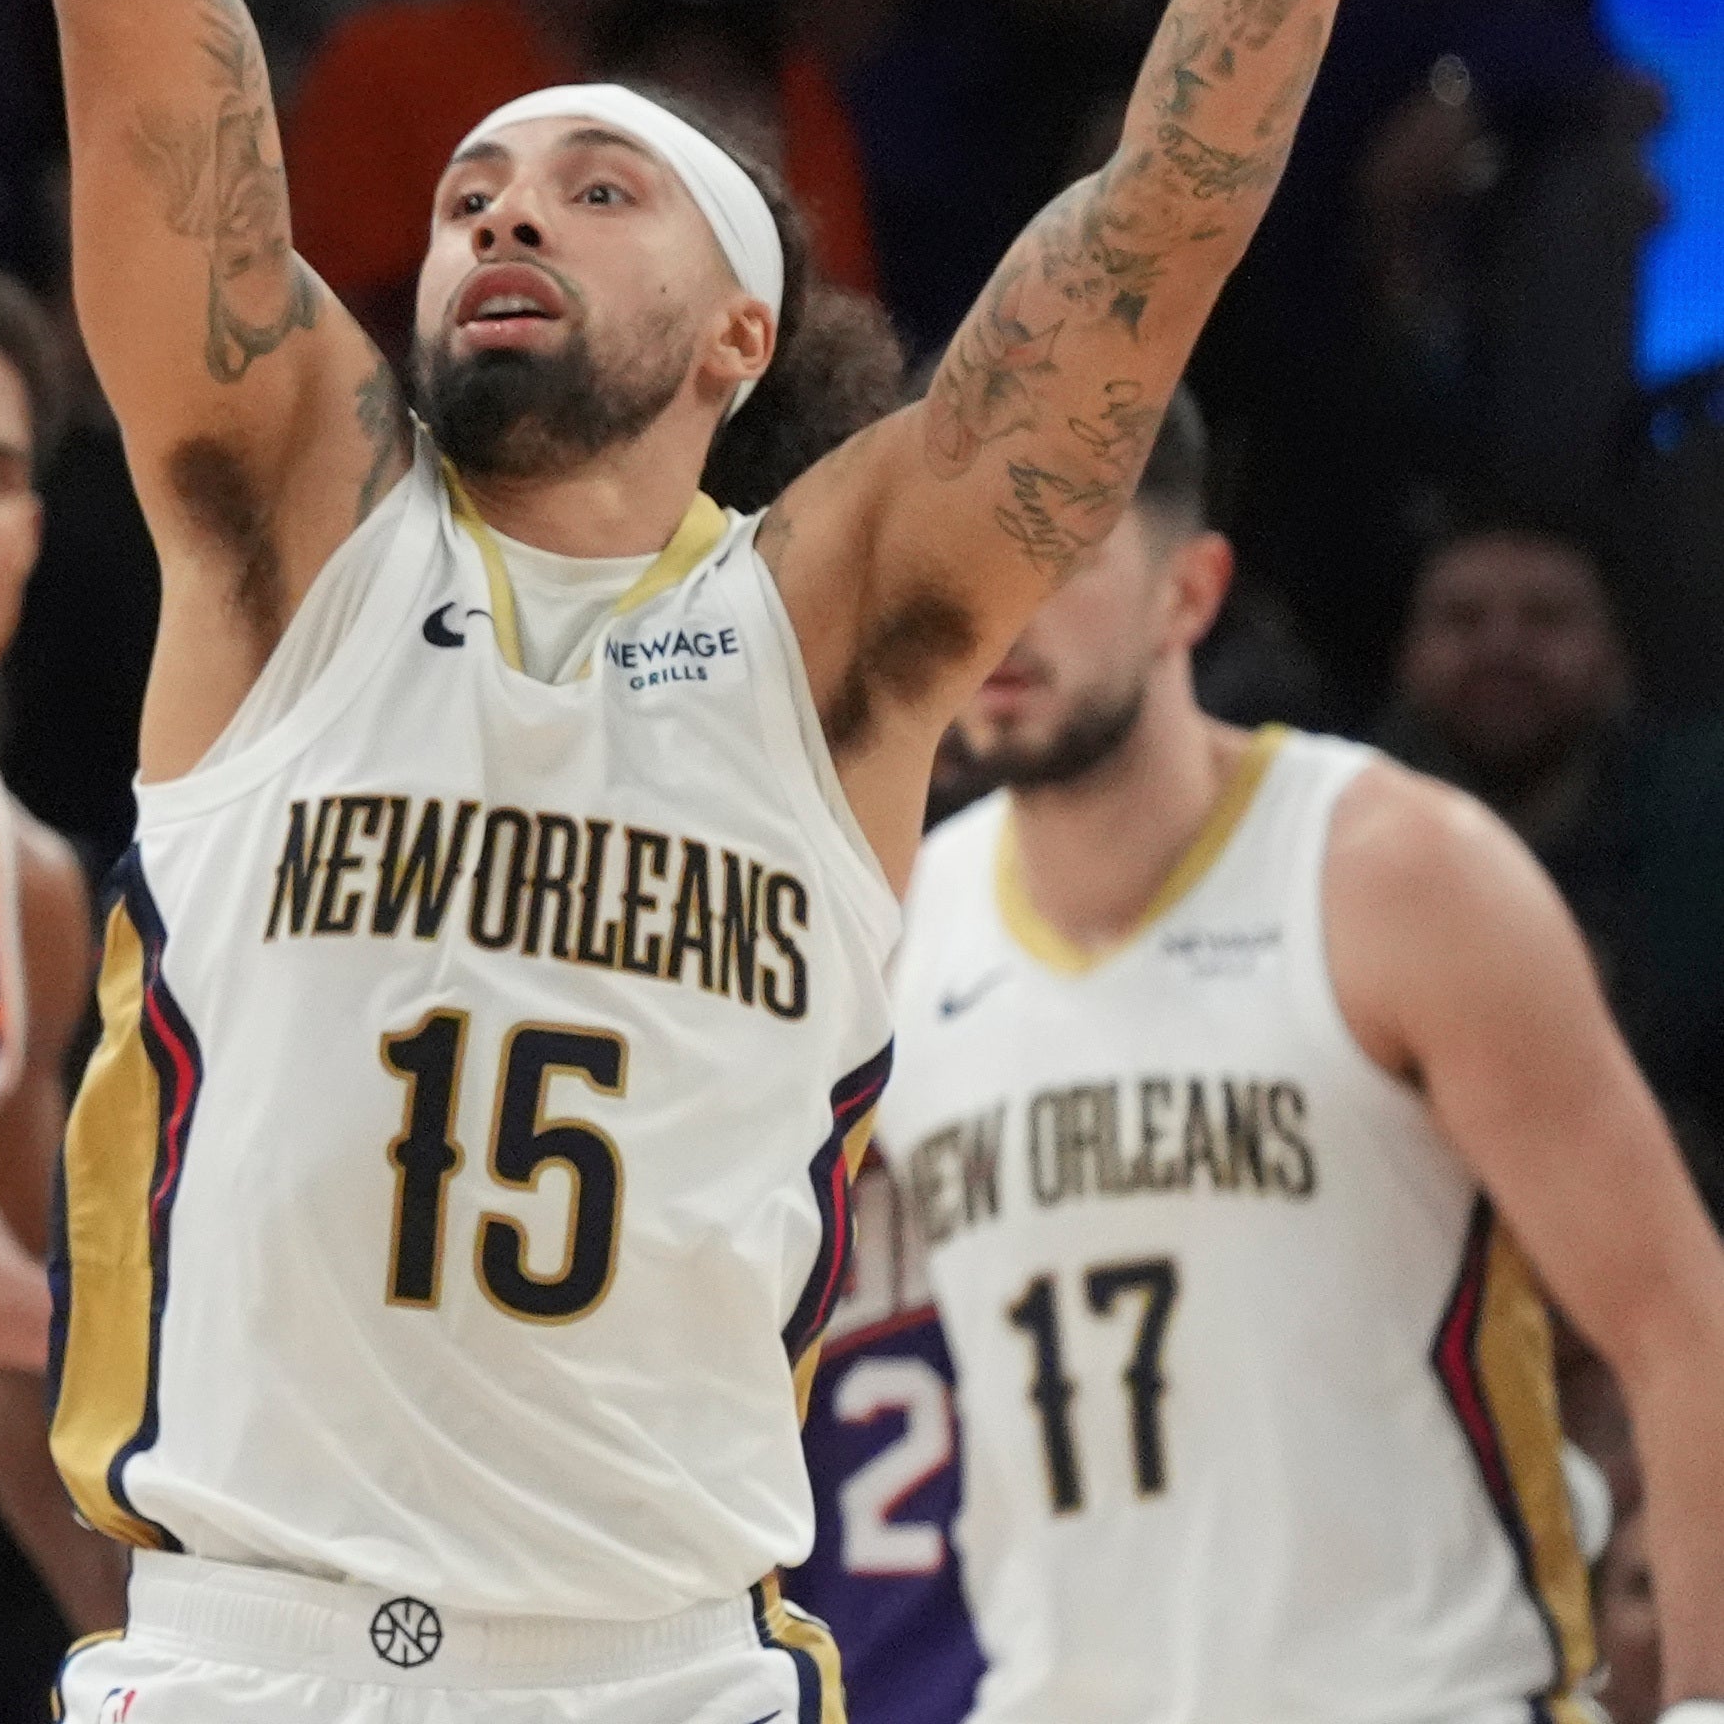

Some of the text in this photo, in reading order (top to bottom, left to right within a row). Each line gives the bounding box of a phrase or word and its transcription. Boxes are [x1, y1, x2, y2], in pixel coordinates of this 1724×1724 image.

[604, 627, 739, 669] NEWAGE
[630, 665, 708, 690] GRILLS
[379, 1006, 631, 1327] 15
[1026, 1074, 1317, 1204] ORLEANS
[832, 1354, 952, 1578] 2
[1005, 1252, 1180, 1518] 17
